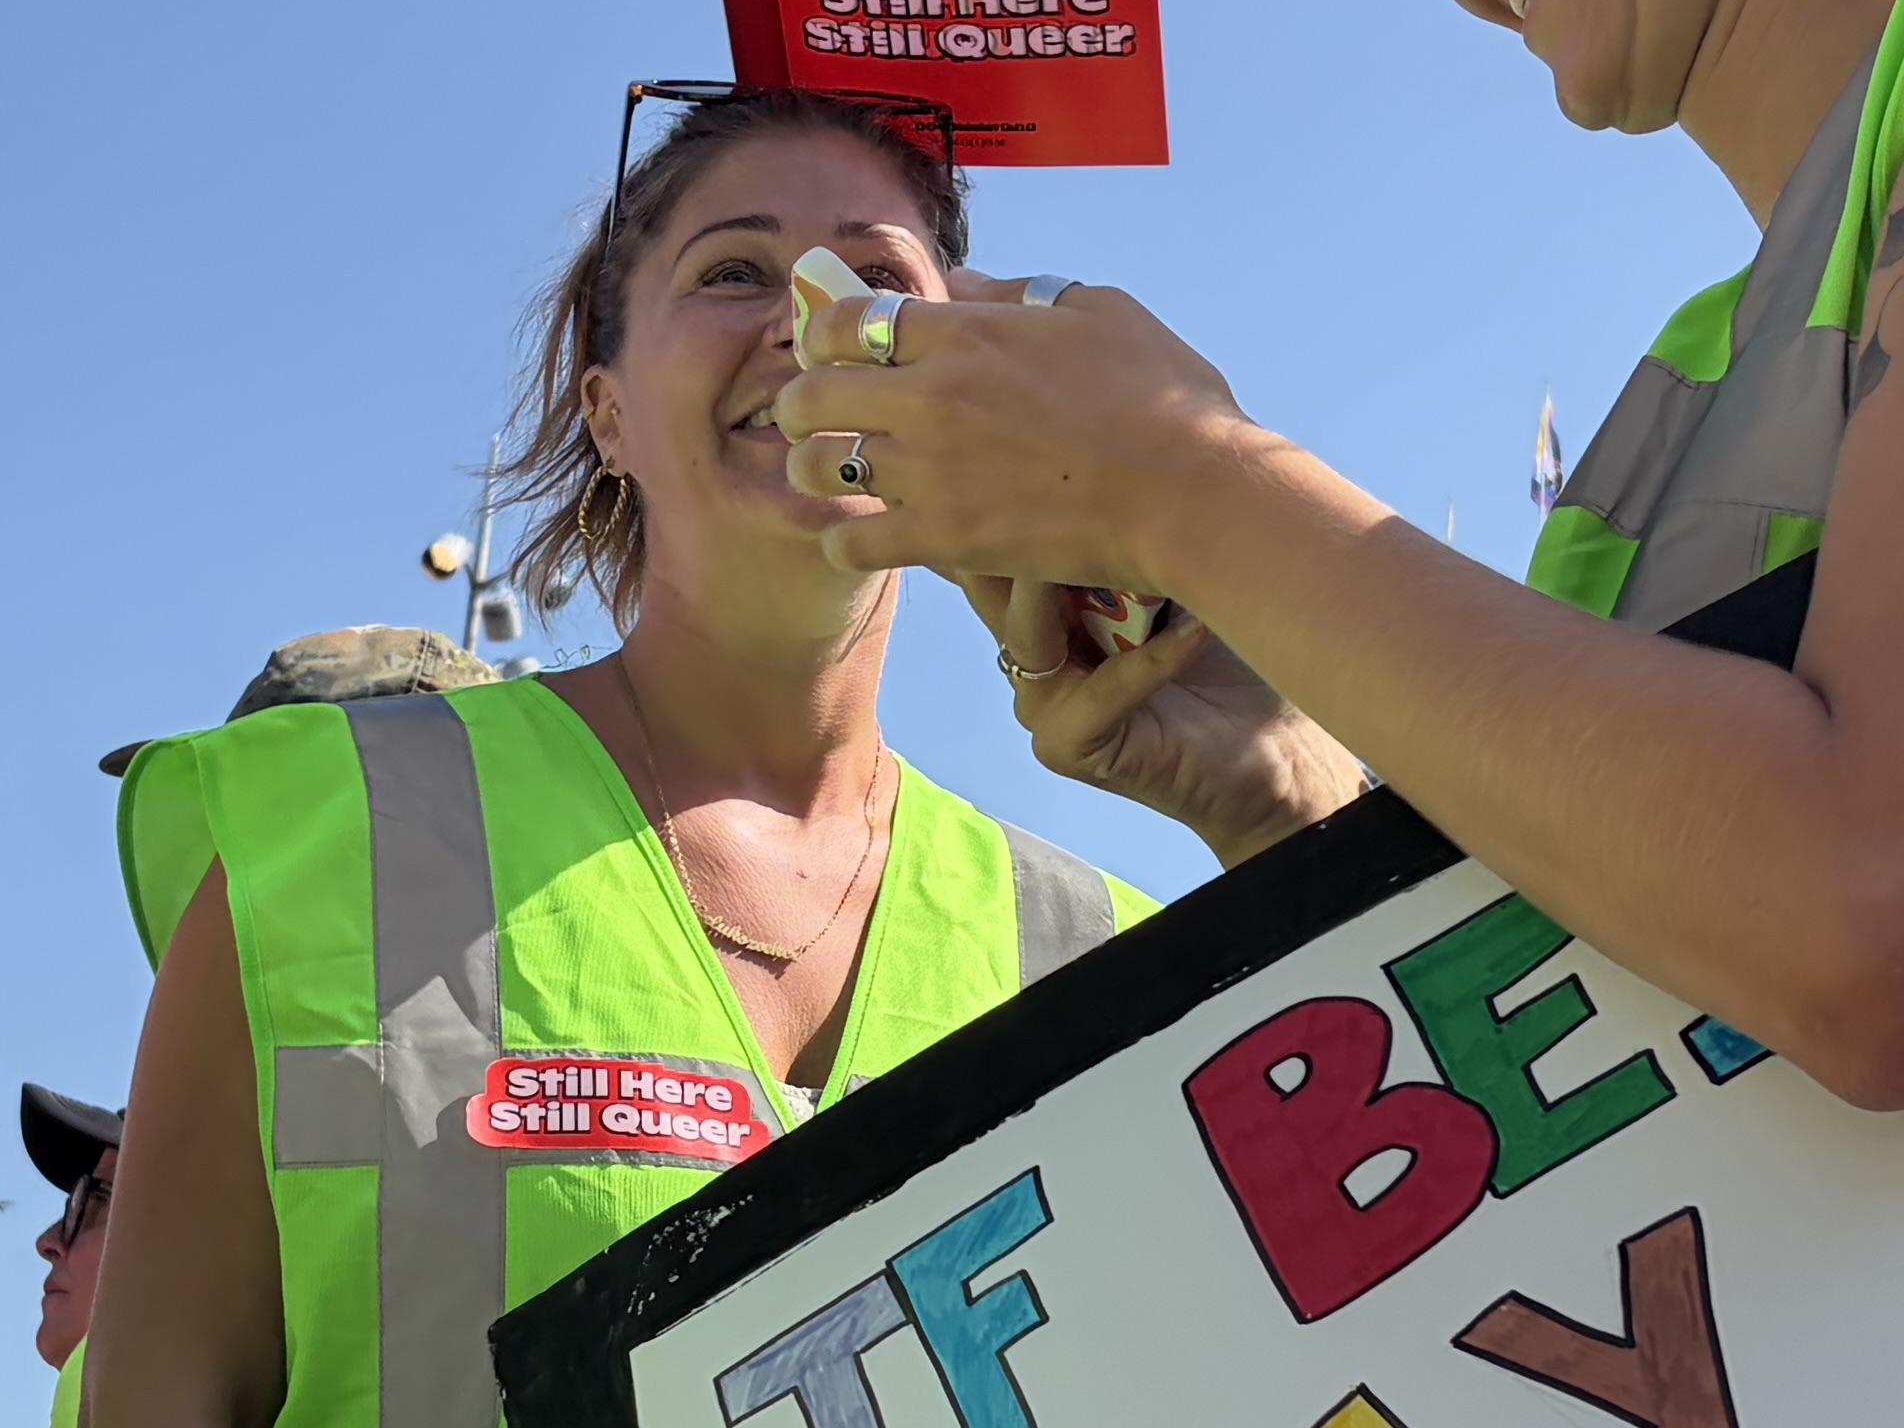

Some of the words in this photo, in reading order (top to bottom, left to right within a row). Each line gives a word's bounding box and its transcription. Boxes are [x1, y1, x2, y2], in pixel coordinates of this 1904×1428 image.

[804, 18, 927, 56] Still
[938, 22, 1137, 60] Queer
[506, 1066, 609, 1099] Still
[620, 1069, 734, 1112] Here
[489, 1100, 592, 1134] Still
[600, 1104, 752, 1148] Queer
